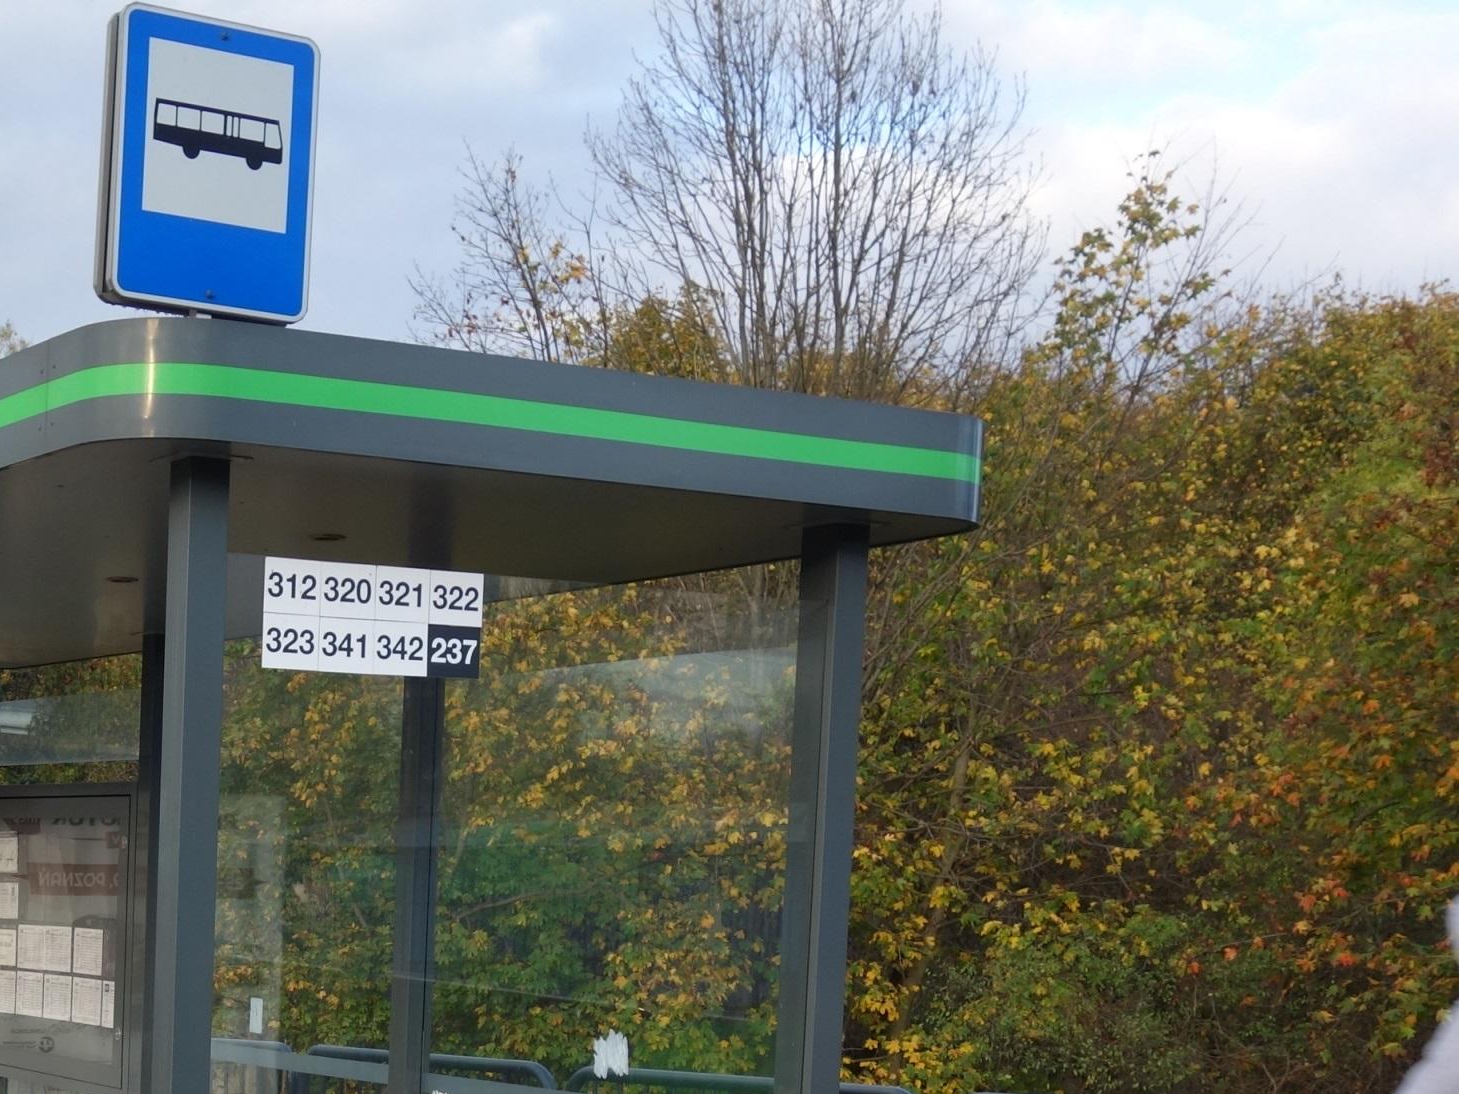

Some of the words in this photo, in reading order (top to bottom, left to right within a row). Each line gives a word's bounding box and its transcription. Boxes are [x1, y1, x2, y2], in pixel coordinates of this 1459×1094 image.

[268, 571, 317, 600] 312
[324, 576, 372, 604] 320
[379, 580, 422, 607] 321
[433, 584, 479, 611] 322
[266, 627, 315, 655] 323
[322, 631, 366, 658] 341
[376, 634, 424, 661] 342
[431, 637, 478, 664] 237
